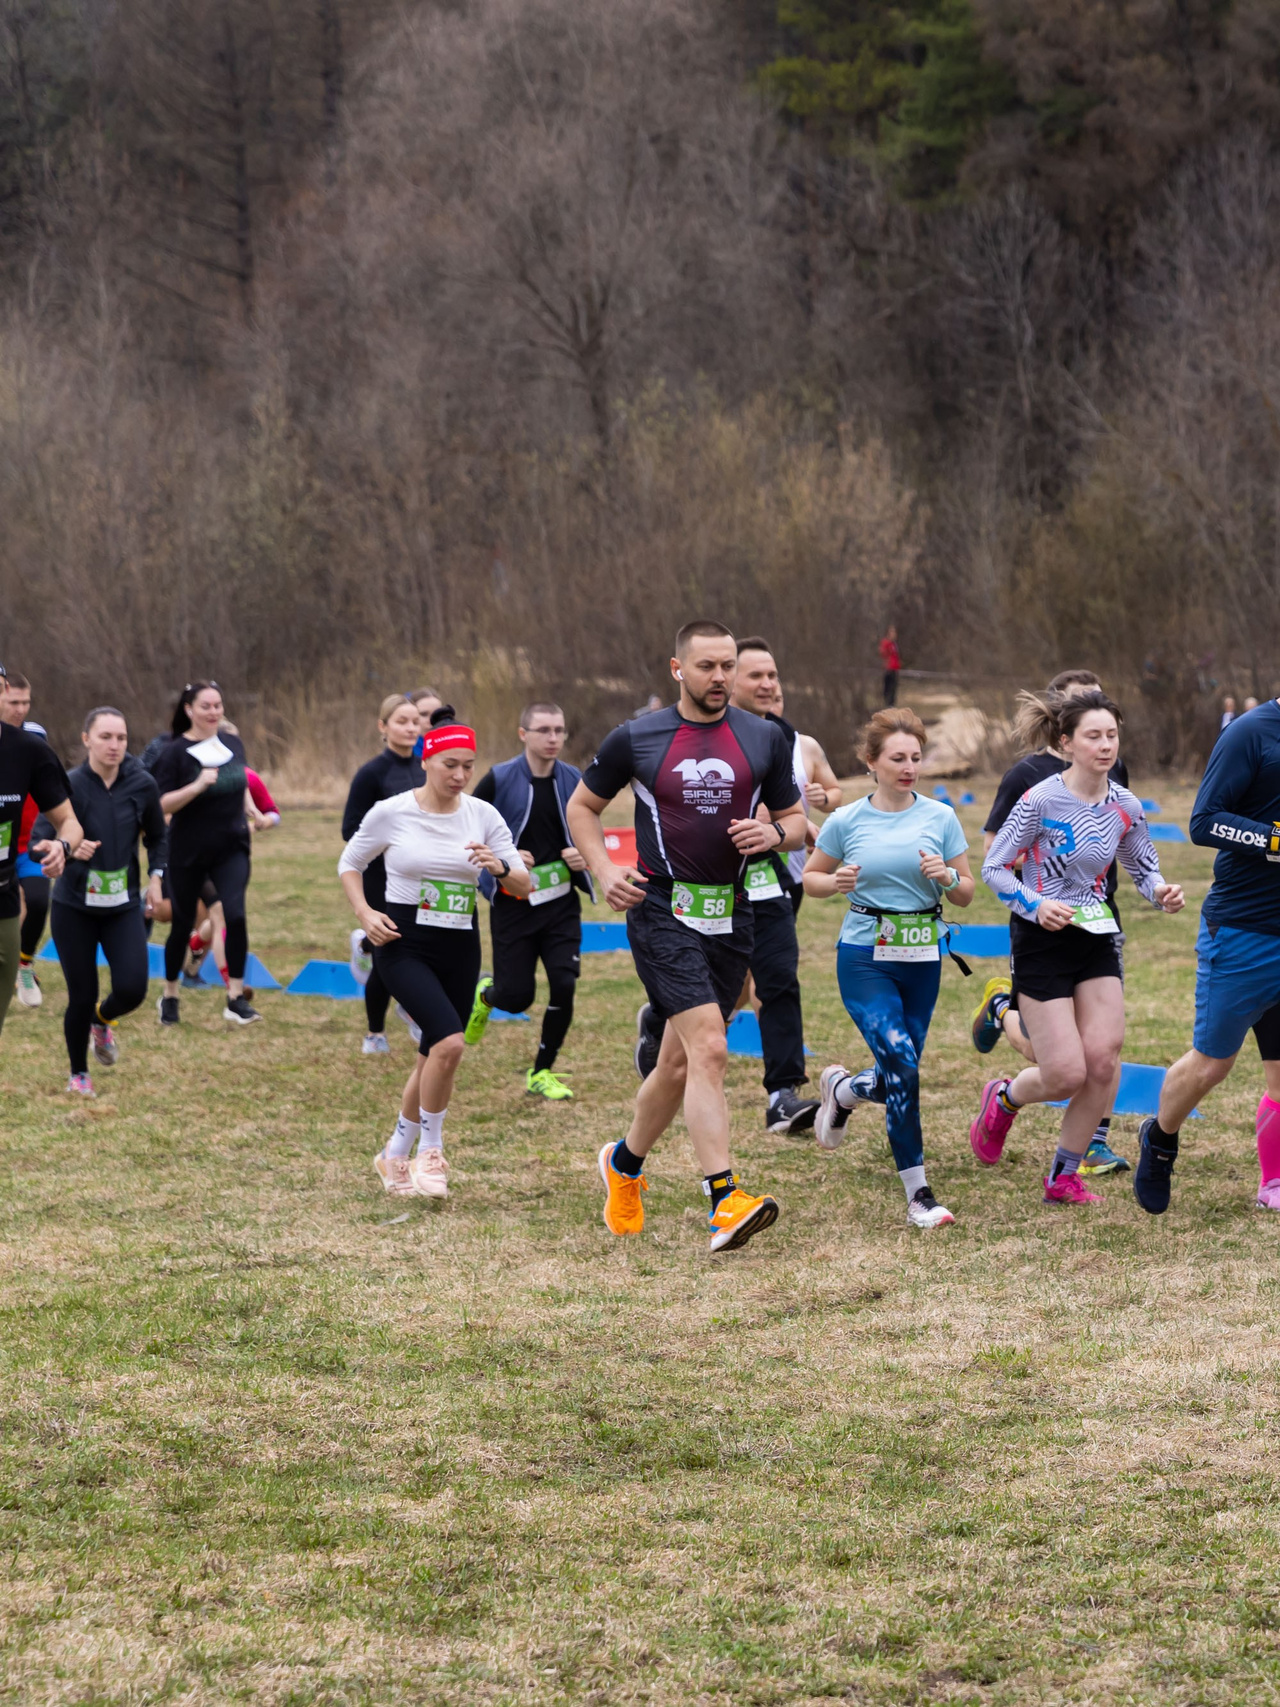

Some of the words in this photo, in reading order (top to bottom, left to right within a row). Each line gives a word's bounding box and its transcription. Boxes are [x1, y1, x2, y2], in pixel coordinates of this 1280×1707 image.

[682, 789, 732, 799] SIRIUS
[696, 805, 719, 815] RAY
[549, 871, 560, 886] 8
[750, 870, 769, 887] 52
[446, 894, 470, 912] 121
[702, 898, 726, 917] 58
[1081, 903, 1105, 920] 98
[900, 926, 932, 945] 108
